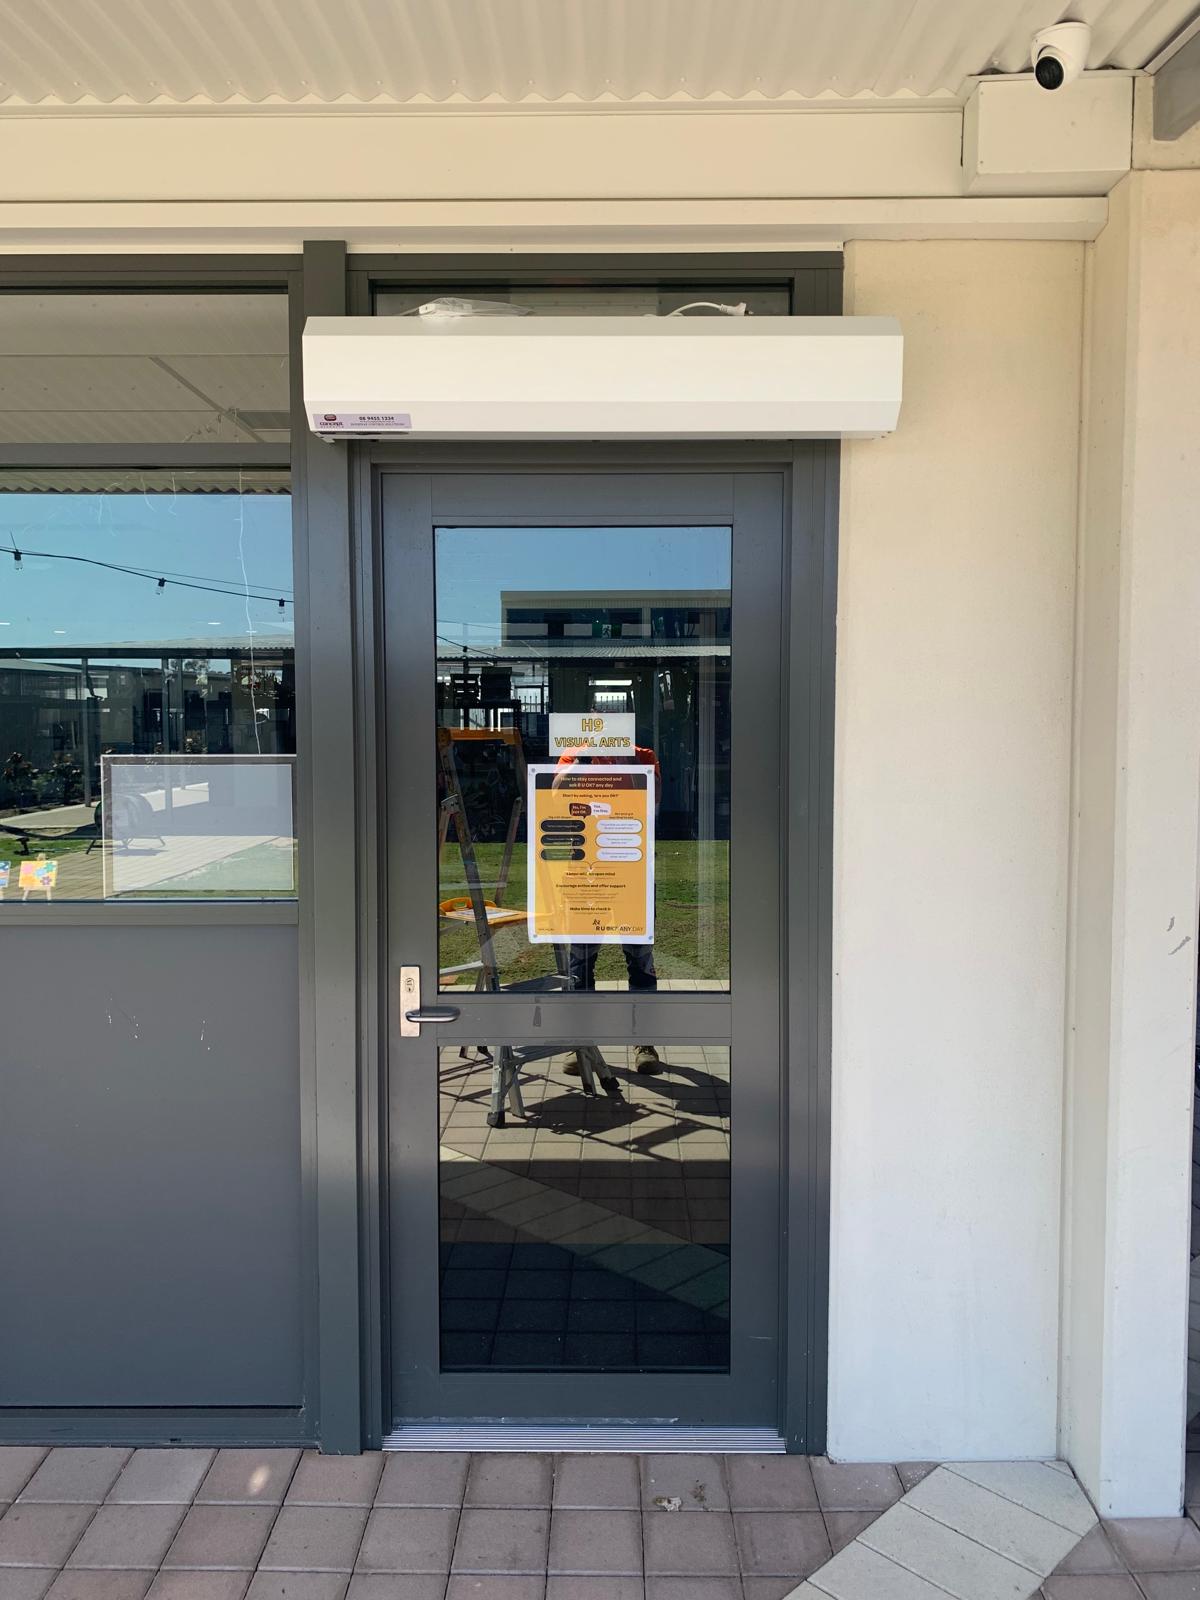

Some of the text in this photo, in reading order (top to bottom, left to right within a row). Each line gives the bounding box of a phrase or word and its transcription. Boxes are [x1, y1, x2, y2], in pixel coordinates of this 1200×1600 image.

[581, 718, 604, 732] H9
[554, 736, 631, 748] VISUAL ARTS
